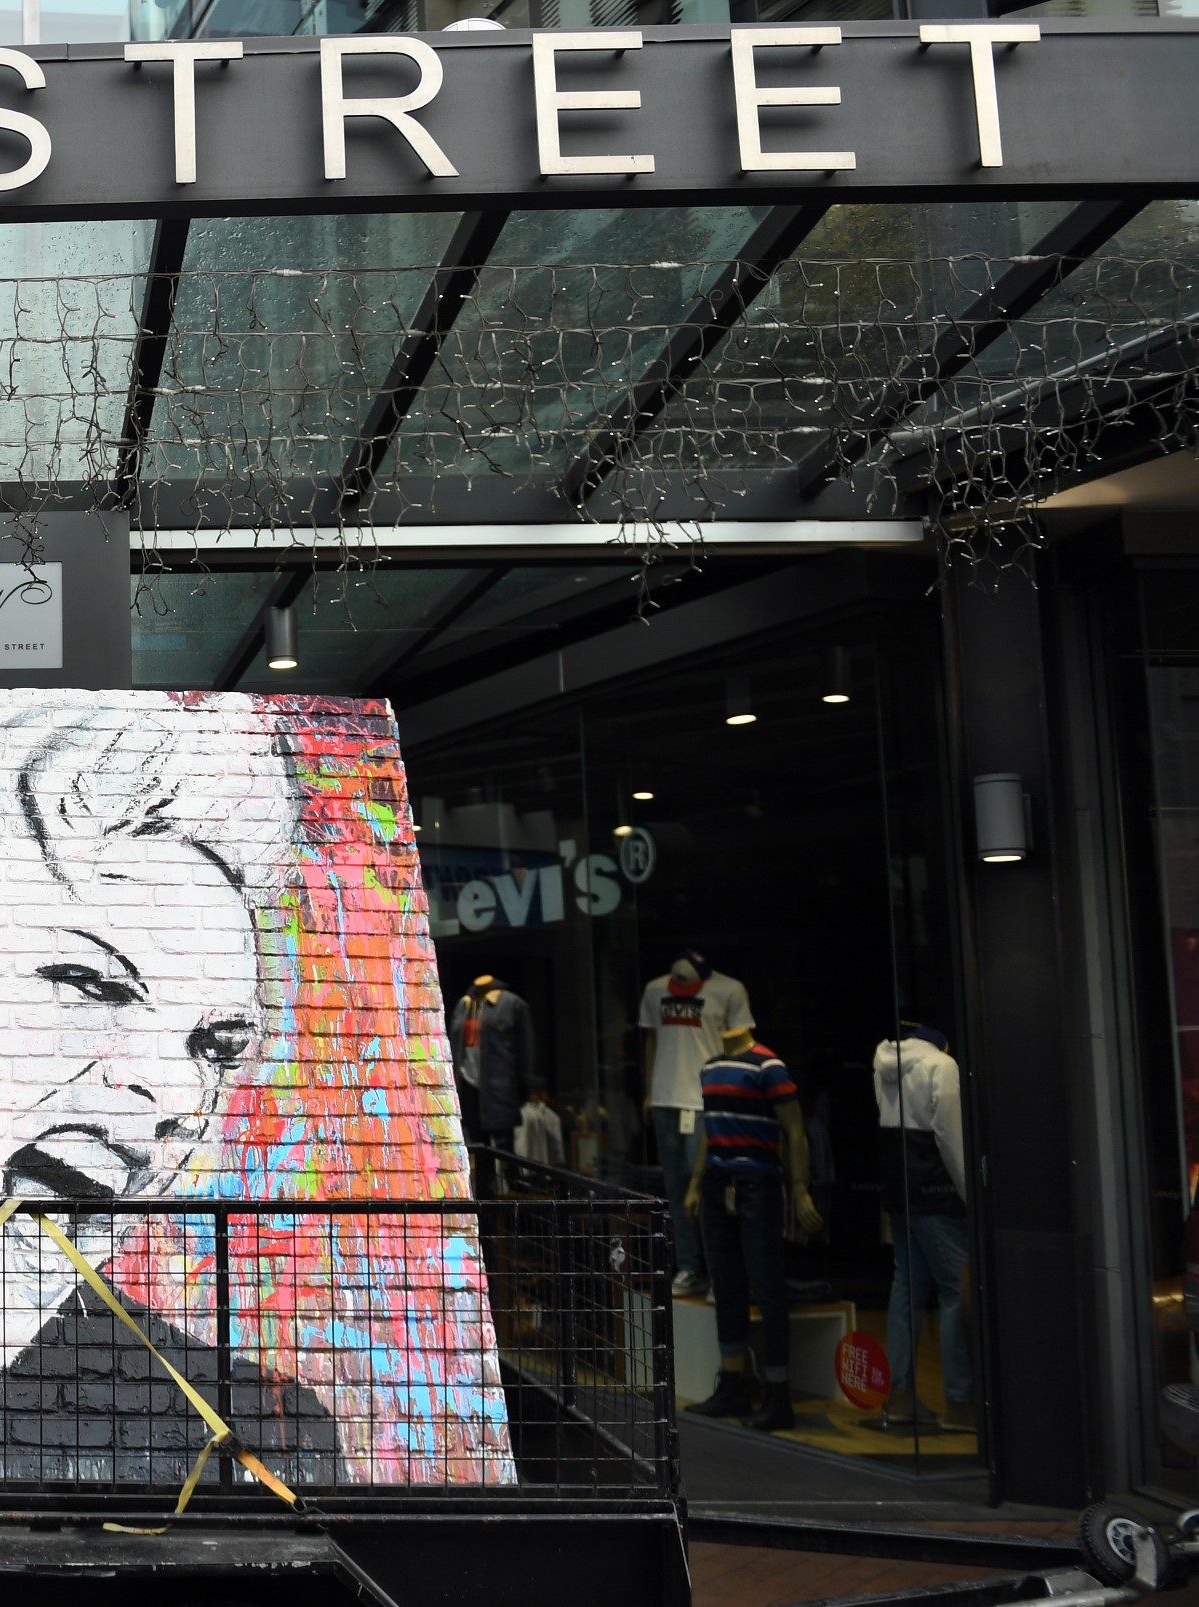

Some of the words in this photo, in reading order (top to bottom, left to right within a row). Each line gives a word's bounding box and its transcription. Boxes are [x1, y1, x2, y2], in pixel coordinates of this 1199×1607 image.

[4, 643, 45, 651] STREET
[842, 1343, 868, 1363] FREE
[842, 1358, 868, 1377] WIFI
[841, 1371, 867, 1392] HERE
